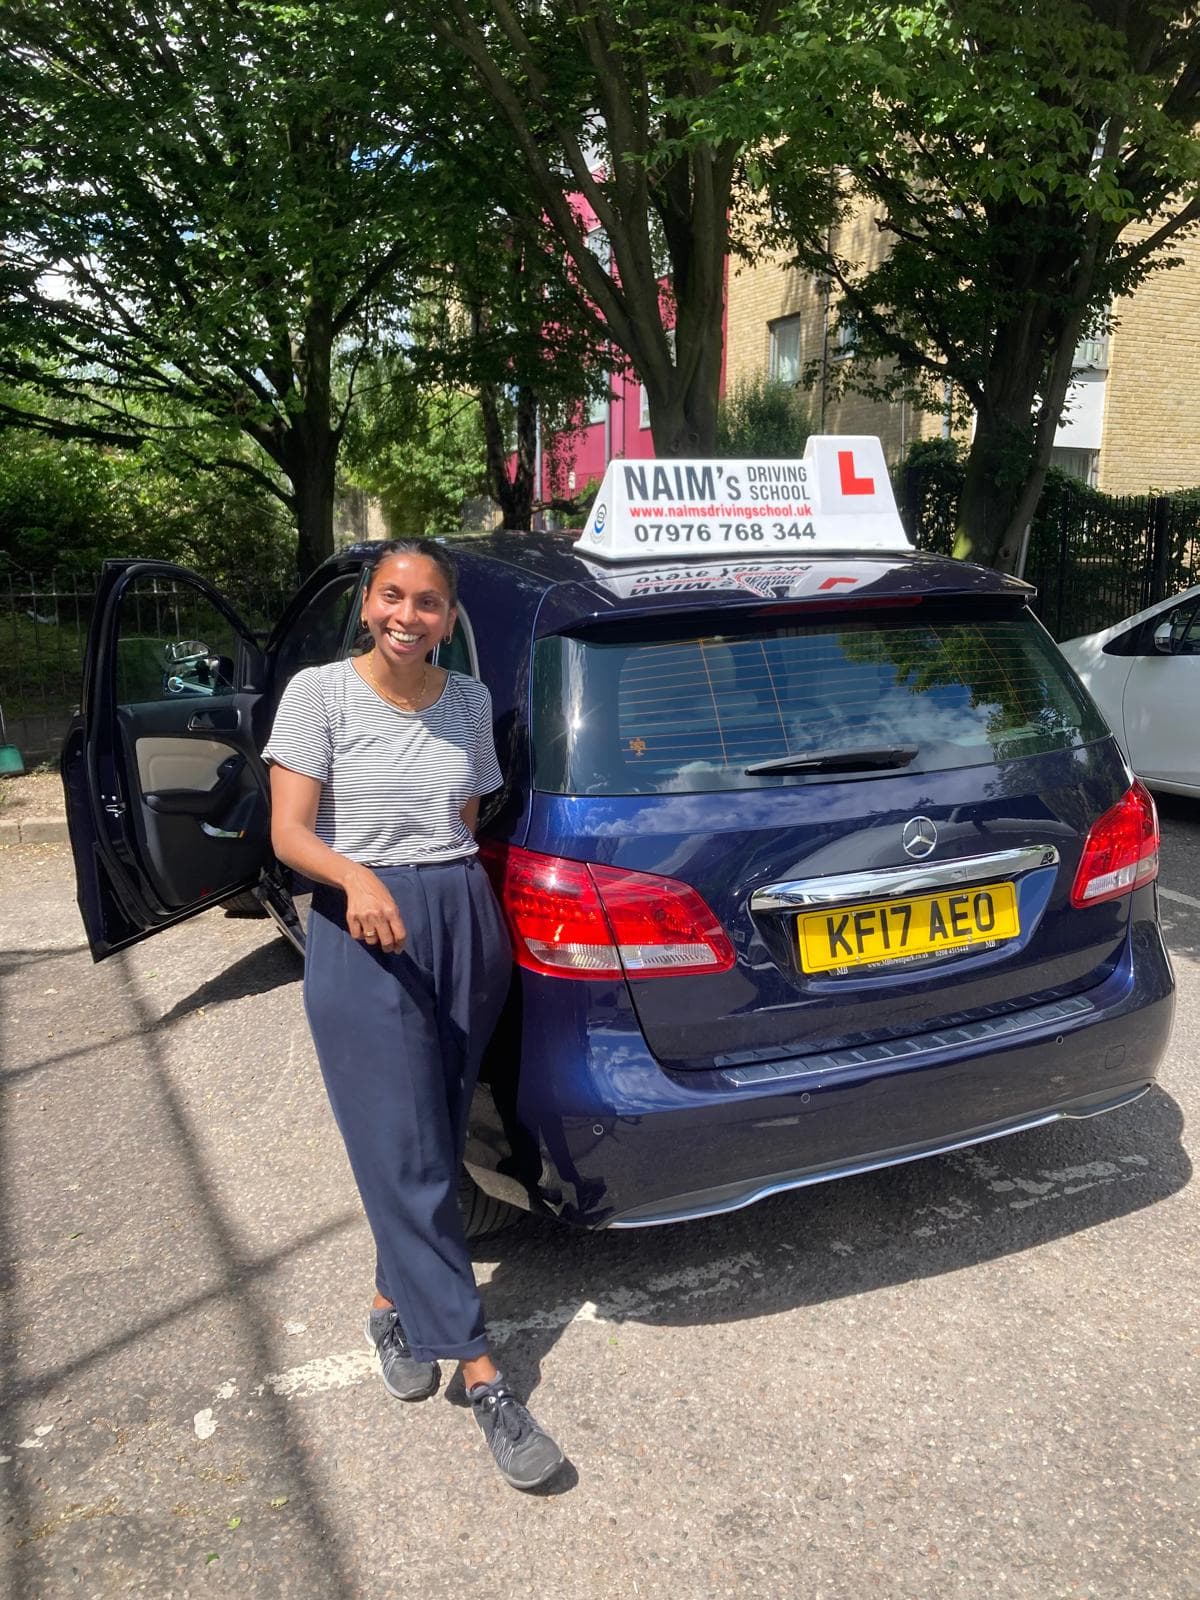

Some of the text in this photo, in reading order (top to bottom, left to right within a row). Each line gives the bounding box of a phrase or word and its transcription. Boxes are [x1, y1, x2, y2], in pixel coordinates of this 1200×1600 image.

[623, 465, 742, 501] NAIM's
[747, 466, 808, 483] DRIVING
[837, 451, 875, 495] L
[750, 484, 811, 501] SCHOOL
[629, 503, 813, 520] www.naimsdrivingschool.uk
[634, 521, 817, 543] 07976 768 344
[826, 892, 996, 958] KF17 AEO
